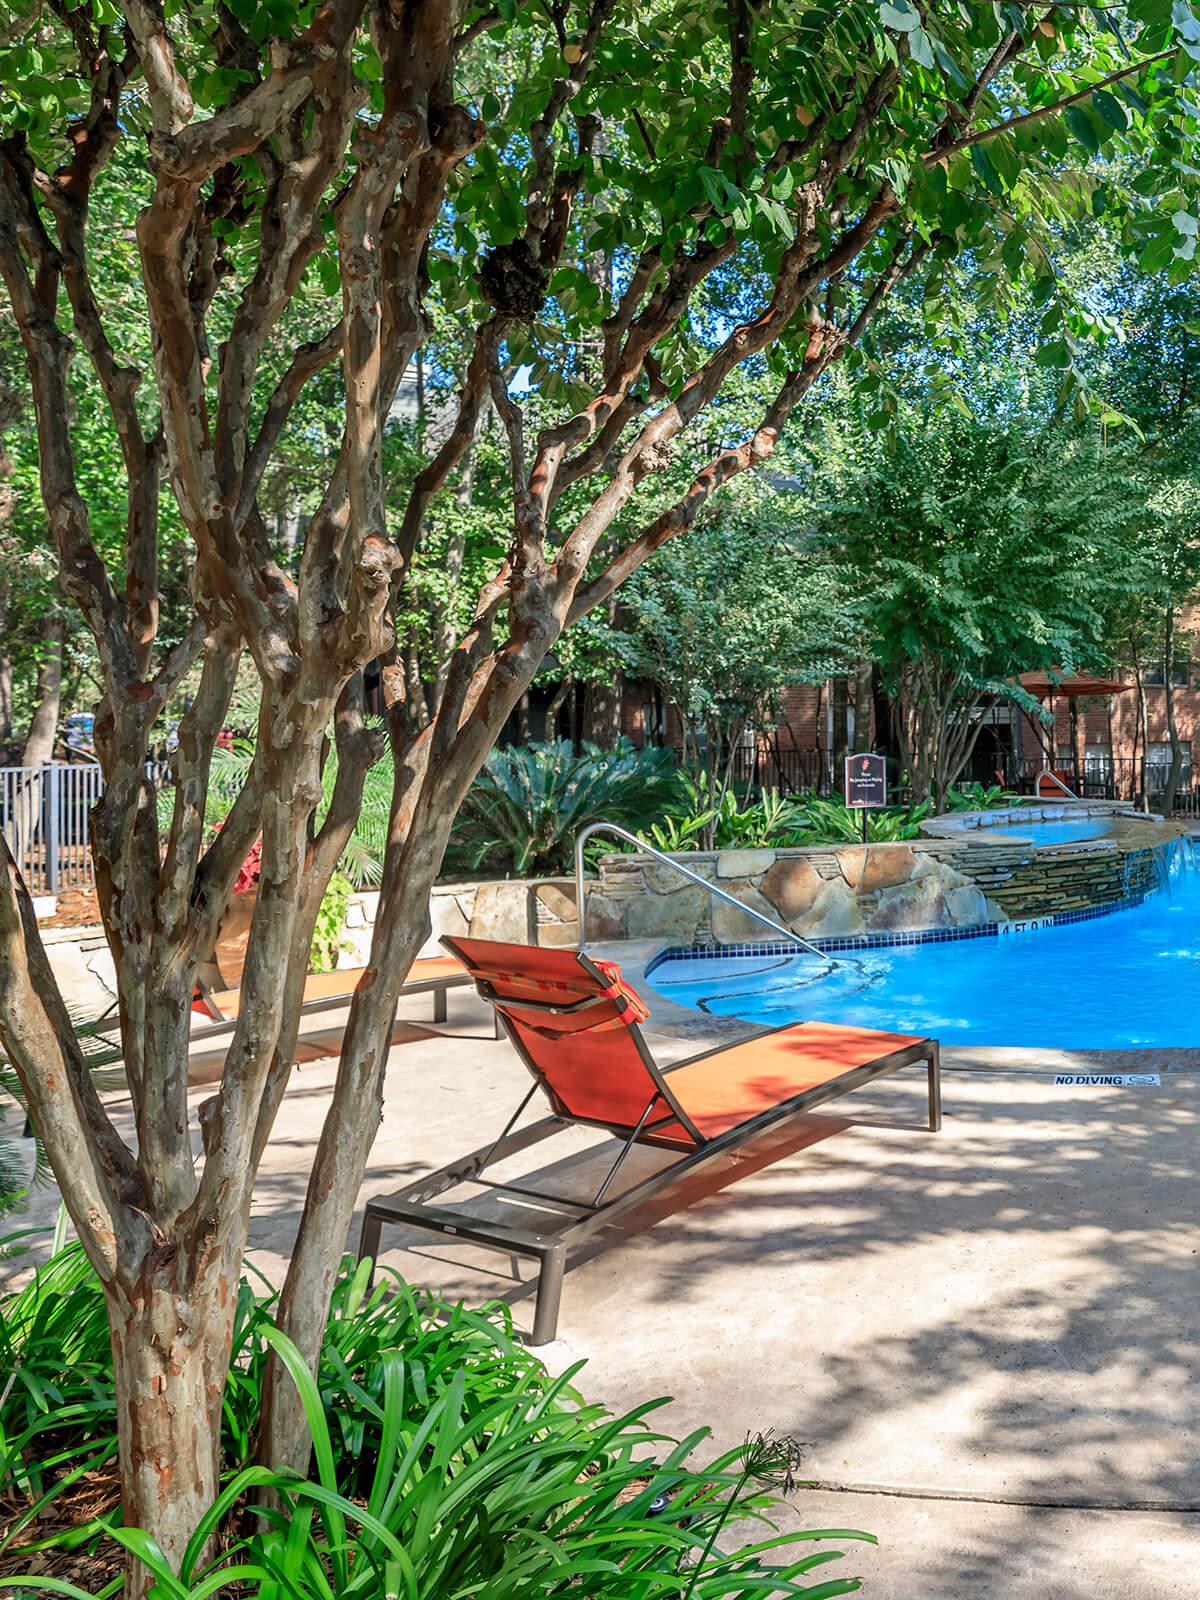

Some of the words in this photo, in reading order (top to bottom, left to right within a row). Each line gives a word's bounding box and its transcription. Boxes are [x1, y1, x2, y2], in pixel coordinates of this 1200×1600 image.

[1015, 922, 1026, 932] FT
[1042, 919, 1053, 929] IN
[1056, 1076, 1073, 1085] NO
[1076, 1076, 1122, 1085] DIVING
